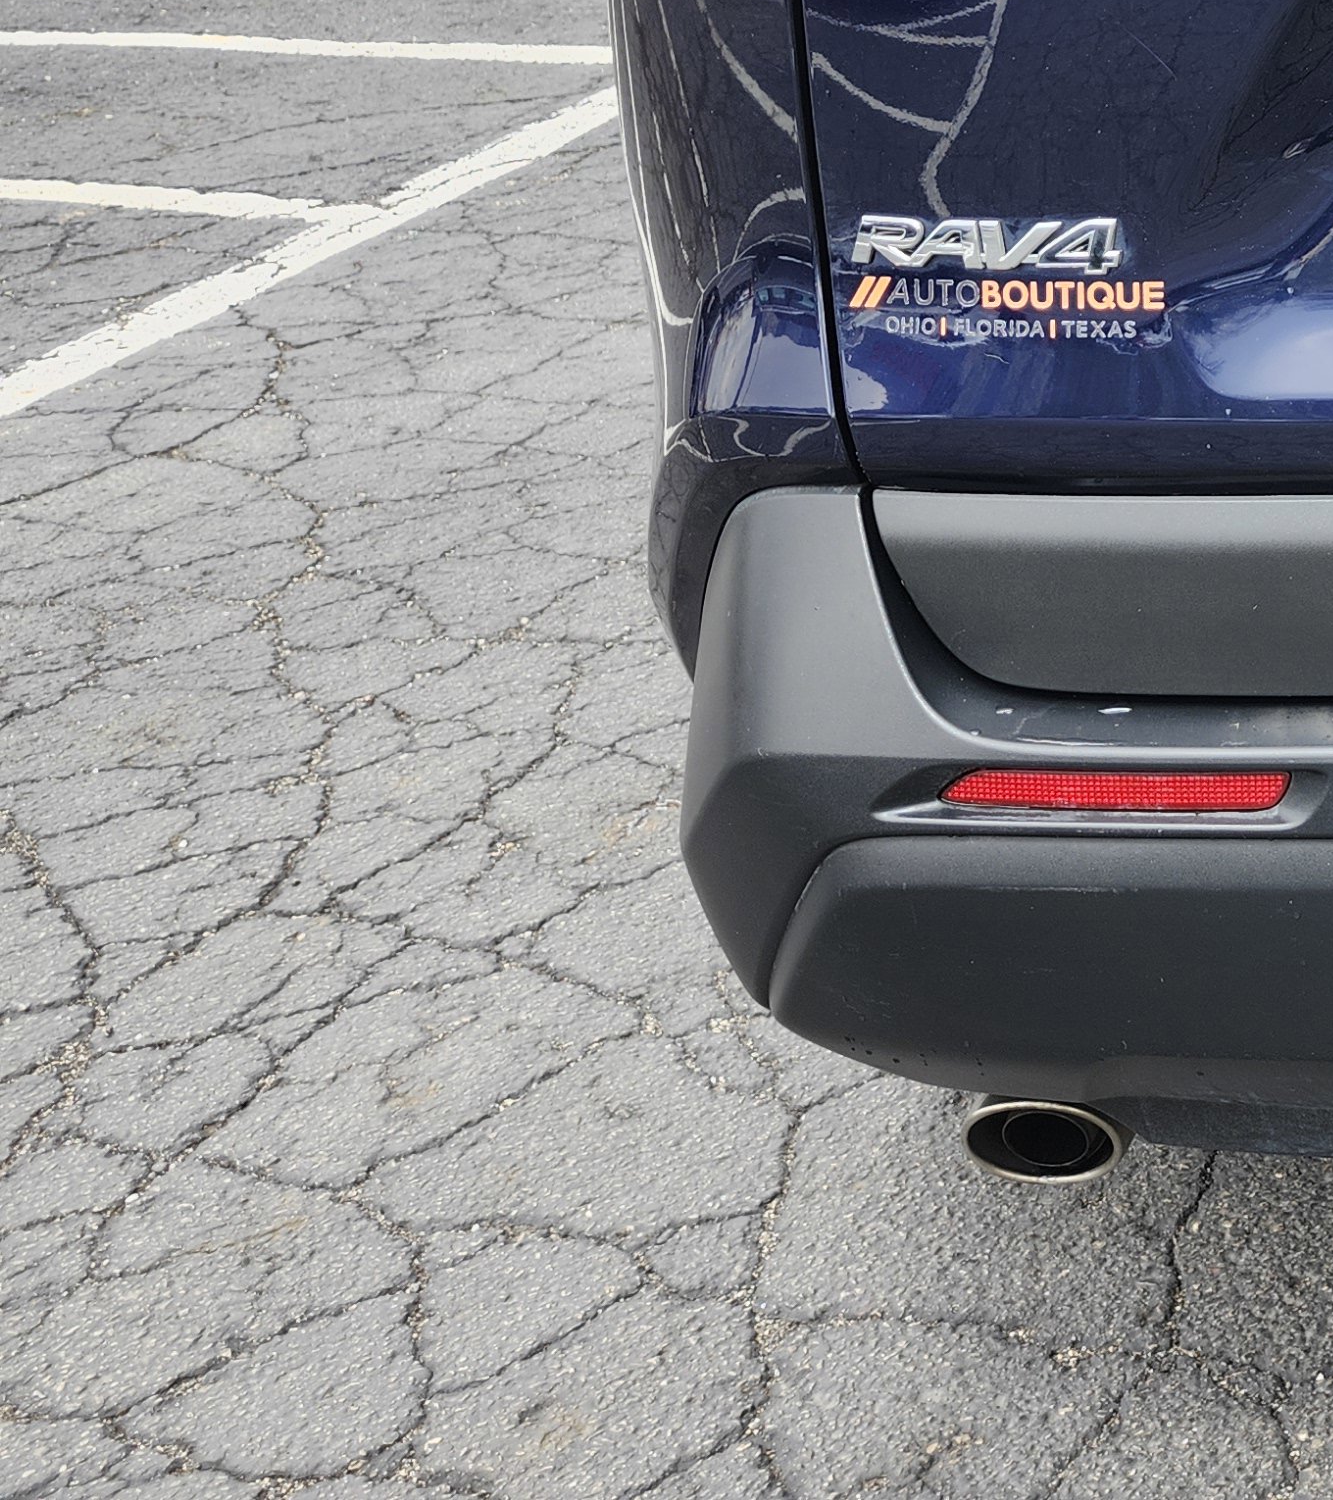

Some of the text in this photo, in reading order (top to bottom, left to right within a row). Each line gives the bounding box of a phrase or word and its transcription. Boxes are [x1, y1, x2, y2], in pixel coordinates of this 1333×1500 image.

[851, 214, 1123, 276] RAV4
[885, 315, 1137, 340] OHIO FLORIDA TEXAS
